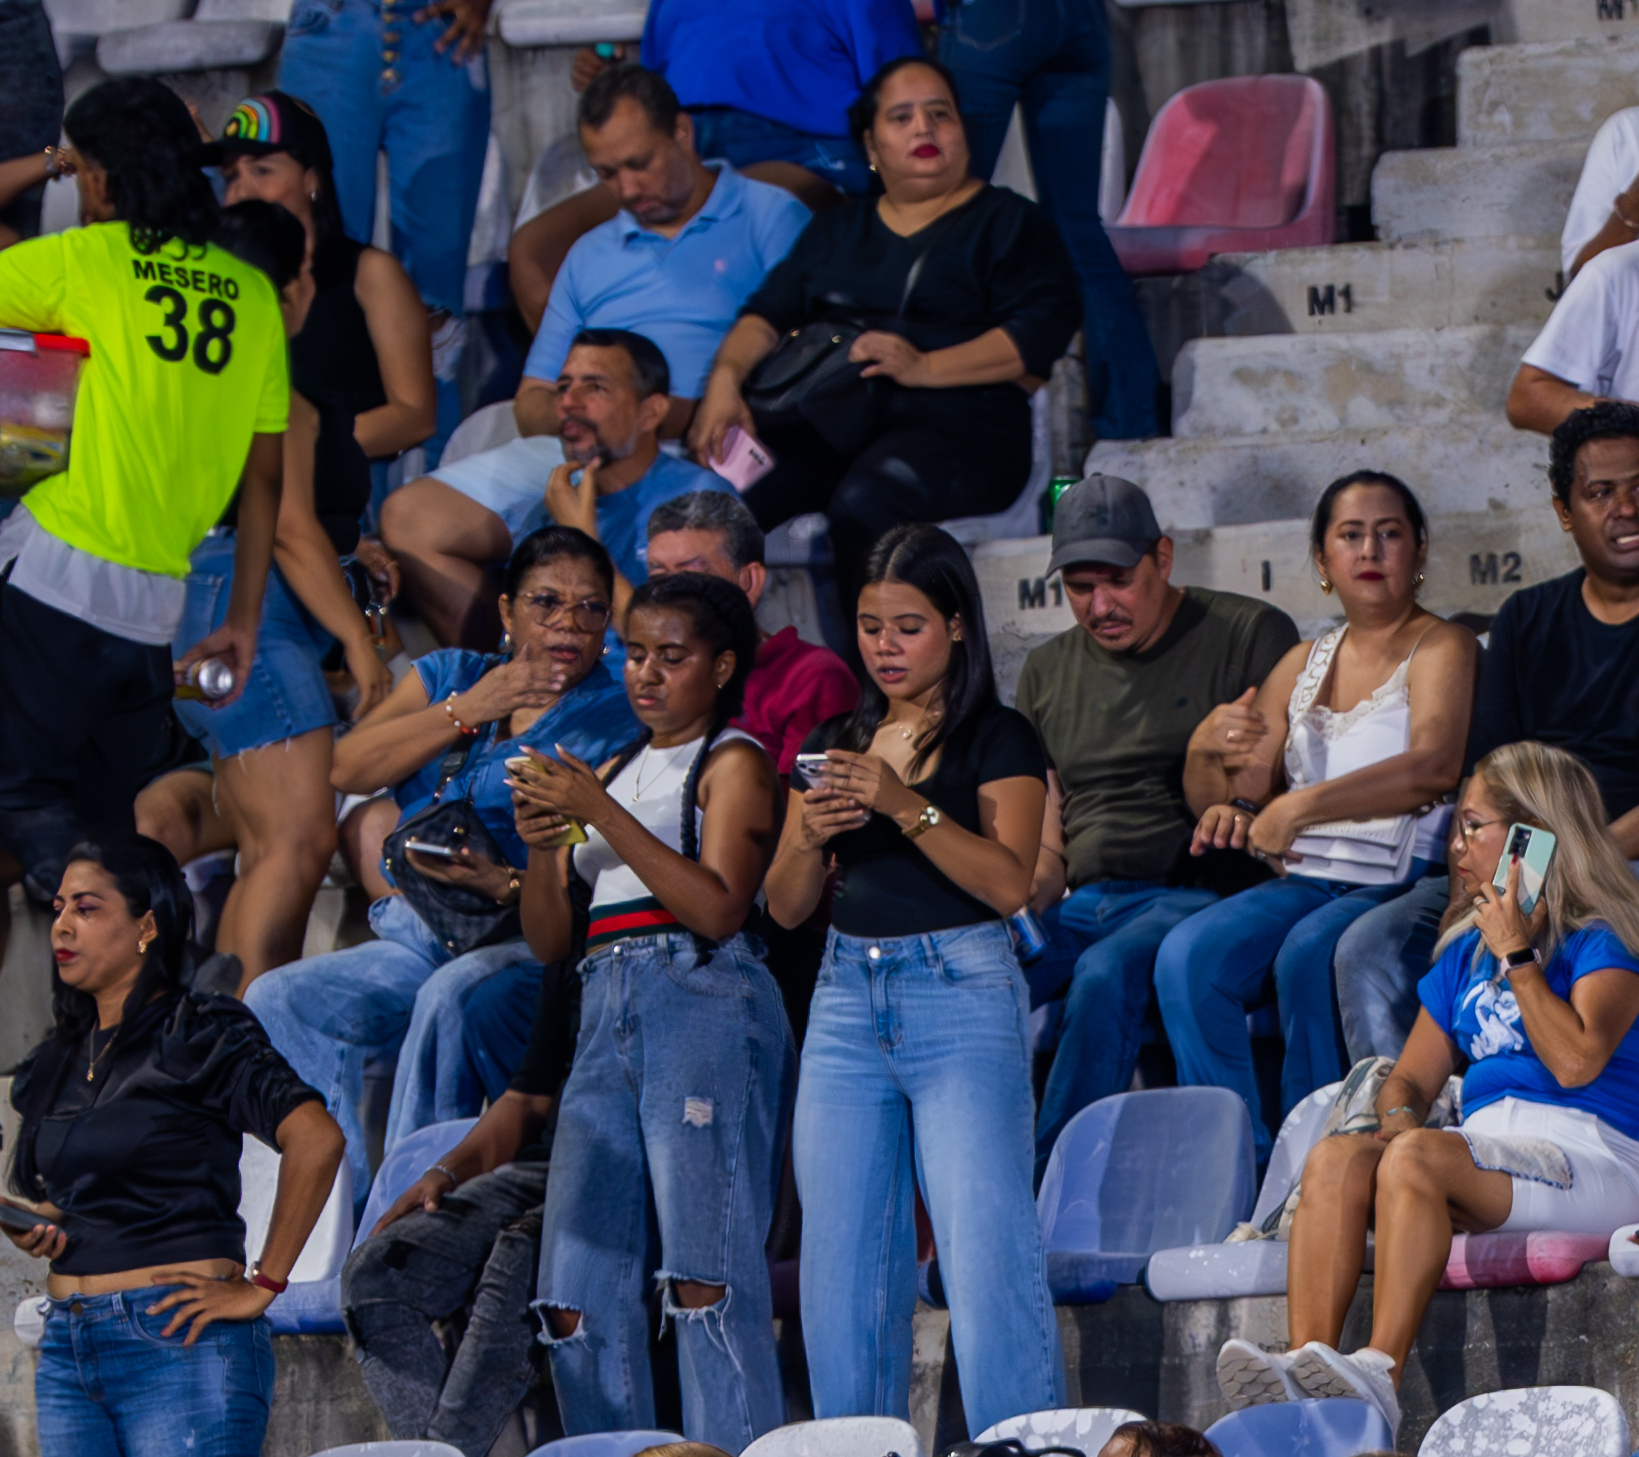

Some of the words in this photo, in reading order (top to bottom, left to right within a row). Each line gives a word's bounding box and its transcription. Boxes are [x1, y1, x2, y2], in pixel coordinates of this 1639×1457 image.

[132, 259, 240, 301] MESERO
[1307, 283, 1352, 316] M1
[145, 285, 236, 375] 38
[1469, 552, 1522, 585] M2
